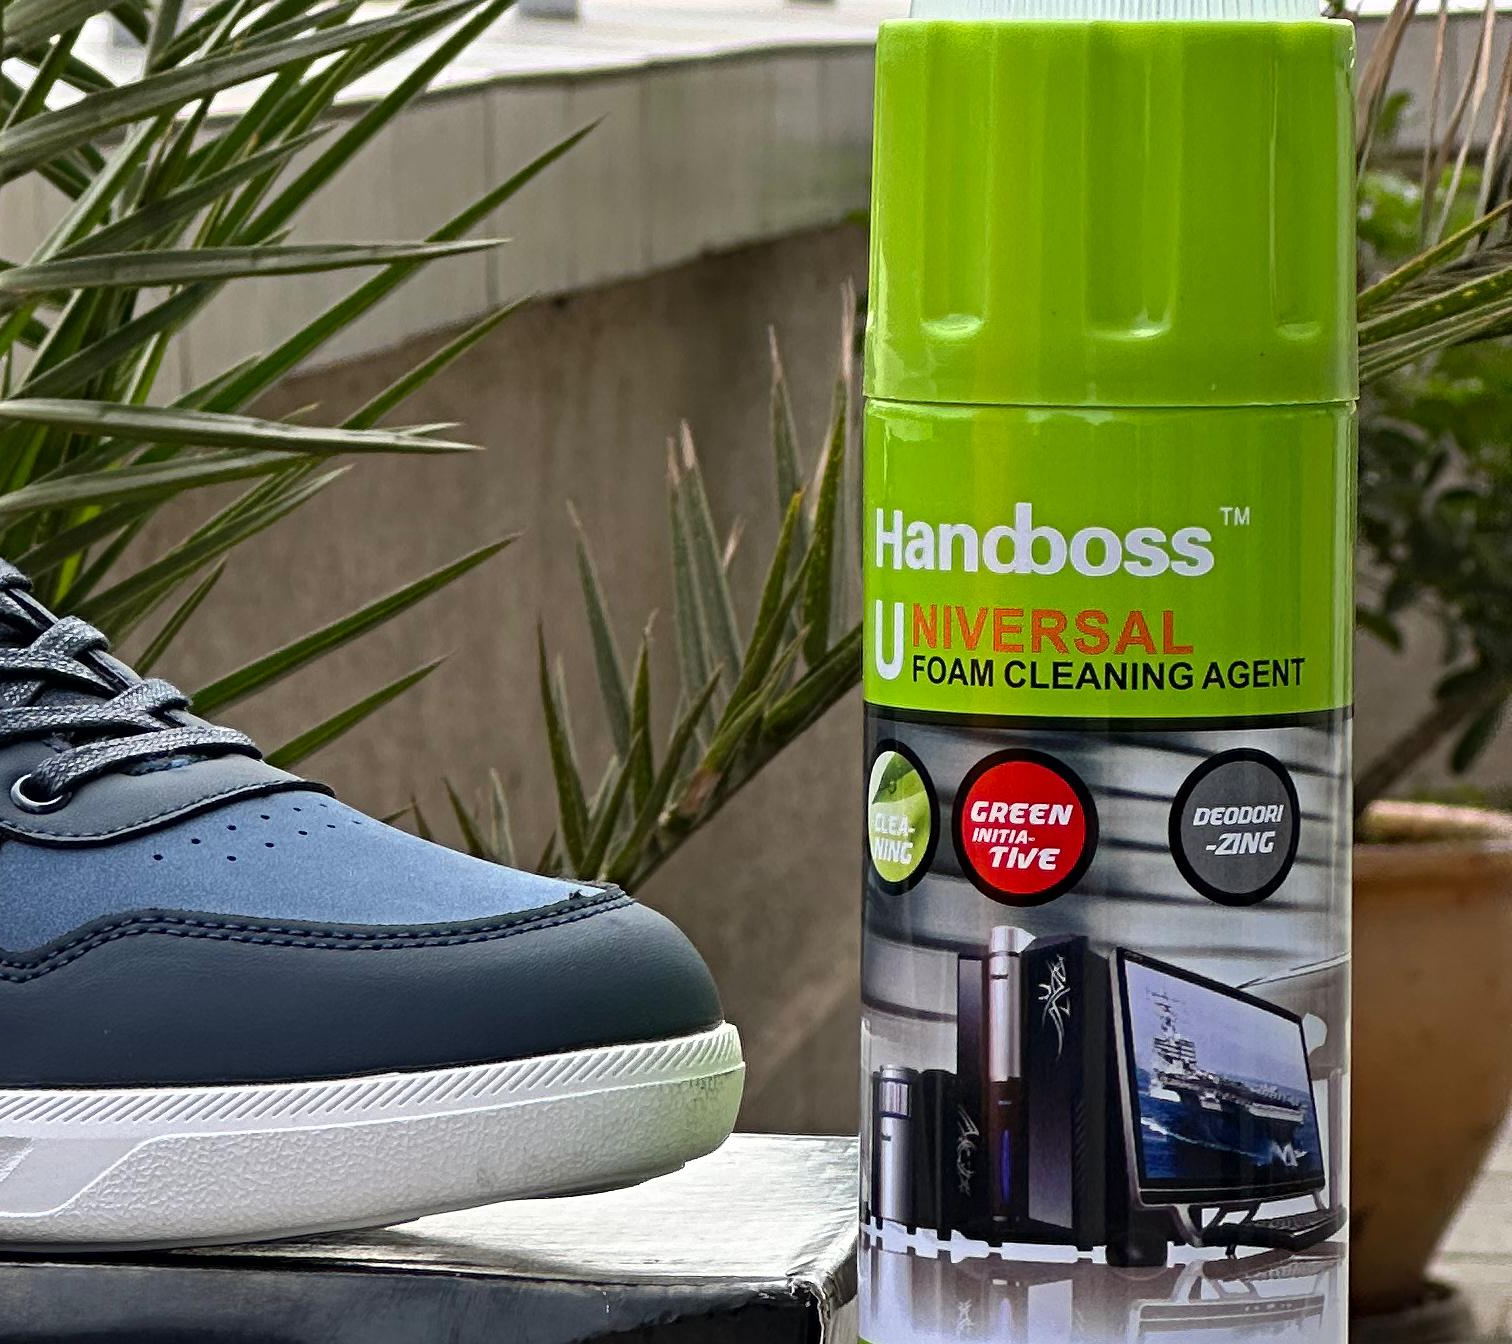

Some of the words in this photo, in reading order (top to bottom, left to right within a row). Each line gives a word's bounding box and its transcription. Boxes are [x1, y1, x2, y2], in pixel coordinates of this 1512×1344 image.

[874, 502, 1215, 577] Handboss
[873, 599, 1194, 680] UNIVERSAL
[912, 655, 994, 688] FOAM
[1004, 659, 1194, 691] CLEANING
[1202, 656, 1306, 689] AGENT
[970, 799, 1074, 826] GREEN
[1192, 803, 1285, 827] DEODORI
[872, 836, 914, 865] NING
[988, 844, 1061, 872] TIVE
[1205, 831, 1276, 857] -ZING
